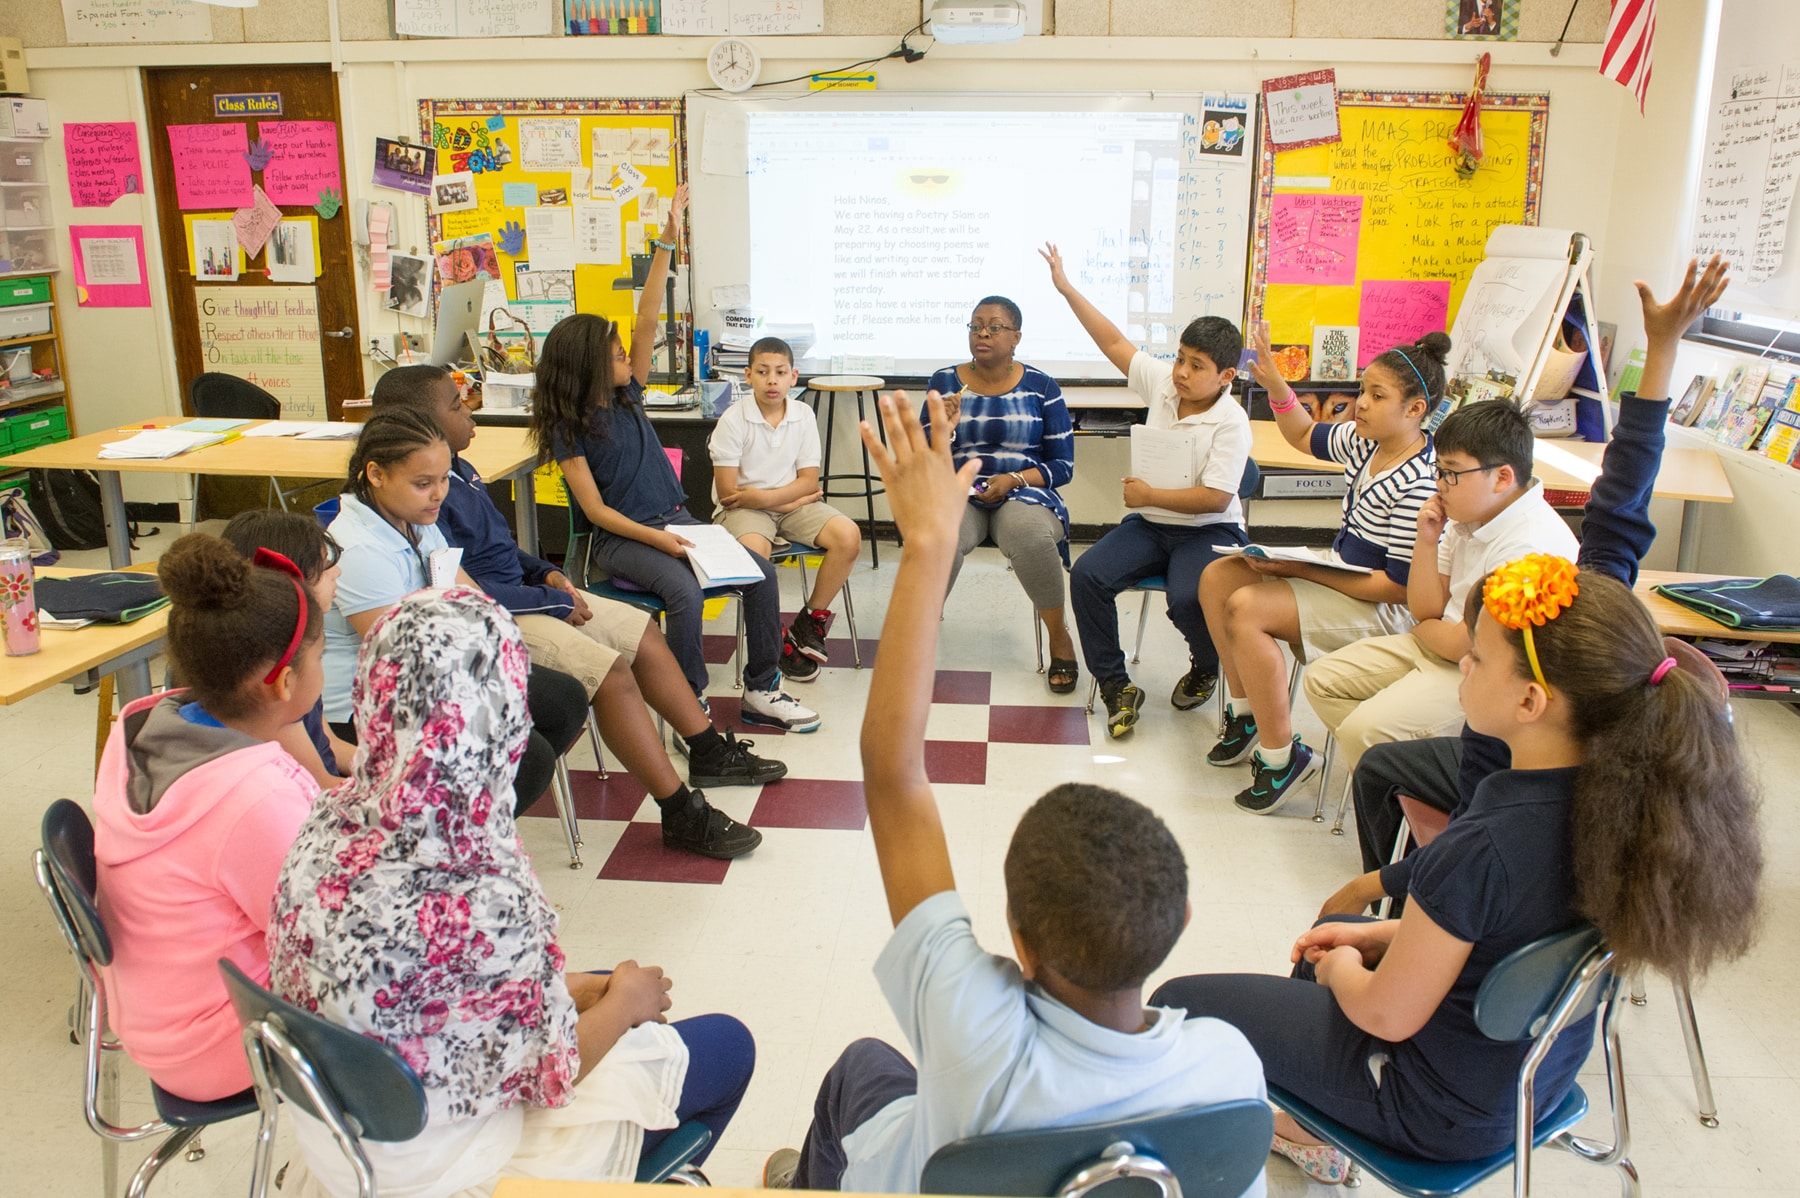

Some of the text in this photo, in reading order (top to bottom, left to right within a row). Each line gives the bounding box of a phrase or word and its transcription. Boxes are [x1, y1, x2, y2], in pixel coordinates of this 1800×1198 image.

[219, 97, 278, 112] Class Rules
[1218, 96, 1248, 110] GOALS
[1272, 96, 1328, 117] This week
[1362, 118, 1458, 143] MCAS PRE
[1363, 144, 1377, 158] the
[620, 161, 640, 181] Class
[614, 184, 634, 198] Jobs
[1335, 176, 1388, 194] organize
[834, 195, 891, 206] Hola Ninos,
[1295, 196, 1316, 207] Word
[1368, 194, 1391, 209] your
[1416, 197, 1445, 210] Decide
[1452, 196, 1468, 209] how
[1470, 197, 1480, 209] to
[834, 210, 990, 222] We are having a Poetry Slam on
[1372, 203, 1398, 216] work
[1416, 213, 1480, 231] Look for a
[834, 225, 854, 236] May
[858, 225, 873, 234] 22.
[877, 225, 889, 234] As
[892, 226, 898, 234] a
[949, 224, 965, 234] will
[968, 224, 981, 234] be
[834, 239, 990, 251] preparing by choosing poems we
[1412, 235, 1450, 248] Make a
[834, 254, 985, 266] like and writing our own. Today
[1412, 255, 1439, 267] Make
[1445, 259, 1451, 267] a
[834, 269, 980, 279] we will finish what we started
[833, 284, 886, 295] yesterday.
[834, 299, 975, 309] We also have a visitor named
[1366, 288, 1407, 311] Adding
[725, 315, 756, 323] COMPOST
[833, 314, 964, 325] Jeff. Please make him feel
[1422, 307, 1435, 321] to
[1365, 320, 1425, 337] our writing
[833, 331, 876, 341] welcome.
[261, 377, 292, 388] voices
[1296, 479, 1332, 488] FOCUS
